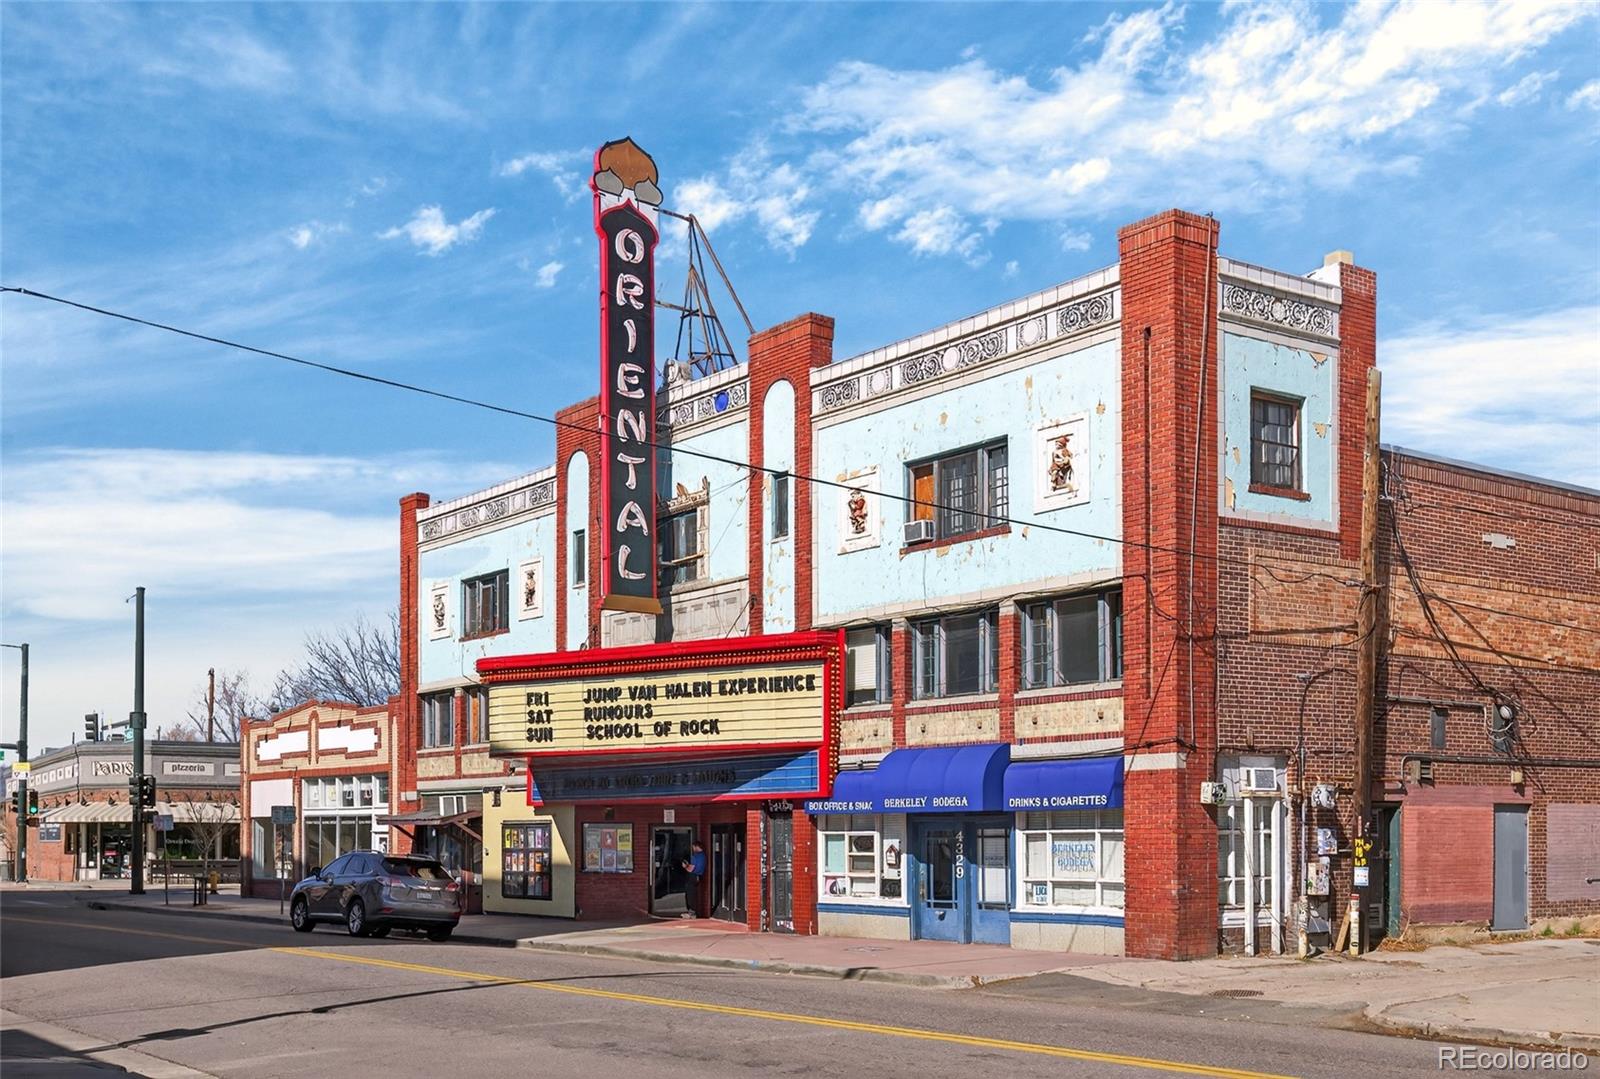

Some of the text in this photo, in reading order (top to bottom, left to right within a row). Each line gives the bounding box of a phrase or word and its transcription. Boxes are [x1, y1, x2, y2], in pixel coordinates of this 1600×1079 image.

[614, 227, 649, 581] ORIENTAL
[583, 674, 817, 705] JUMP VAN HALEN EXPERIENCE
[526, 692, 550, 707] FRI
[526, 708, 553, 725] SAT
[584, 704, 654, 724] RUMOURS
[526, 727, 554, 743] SUN
[586, 718, 720, 741] SCHOOL OF ROCK
[171, 763, 206, 773] pizzeria
[808, 802, 823, 811] BOX
[823, 802, 848, 811] OFFICE
[884, 796, 969, 808] BERKELEY BODEGA
[1009, 795, 1107, 807] DRINKS & CIGARETTES
[955, 830, 965, 879] 4329
